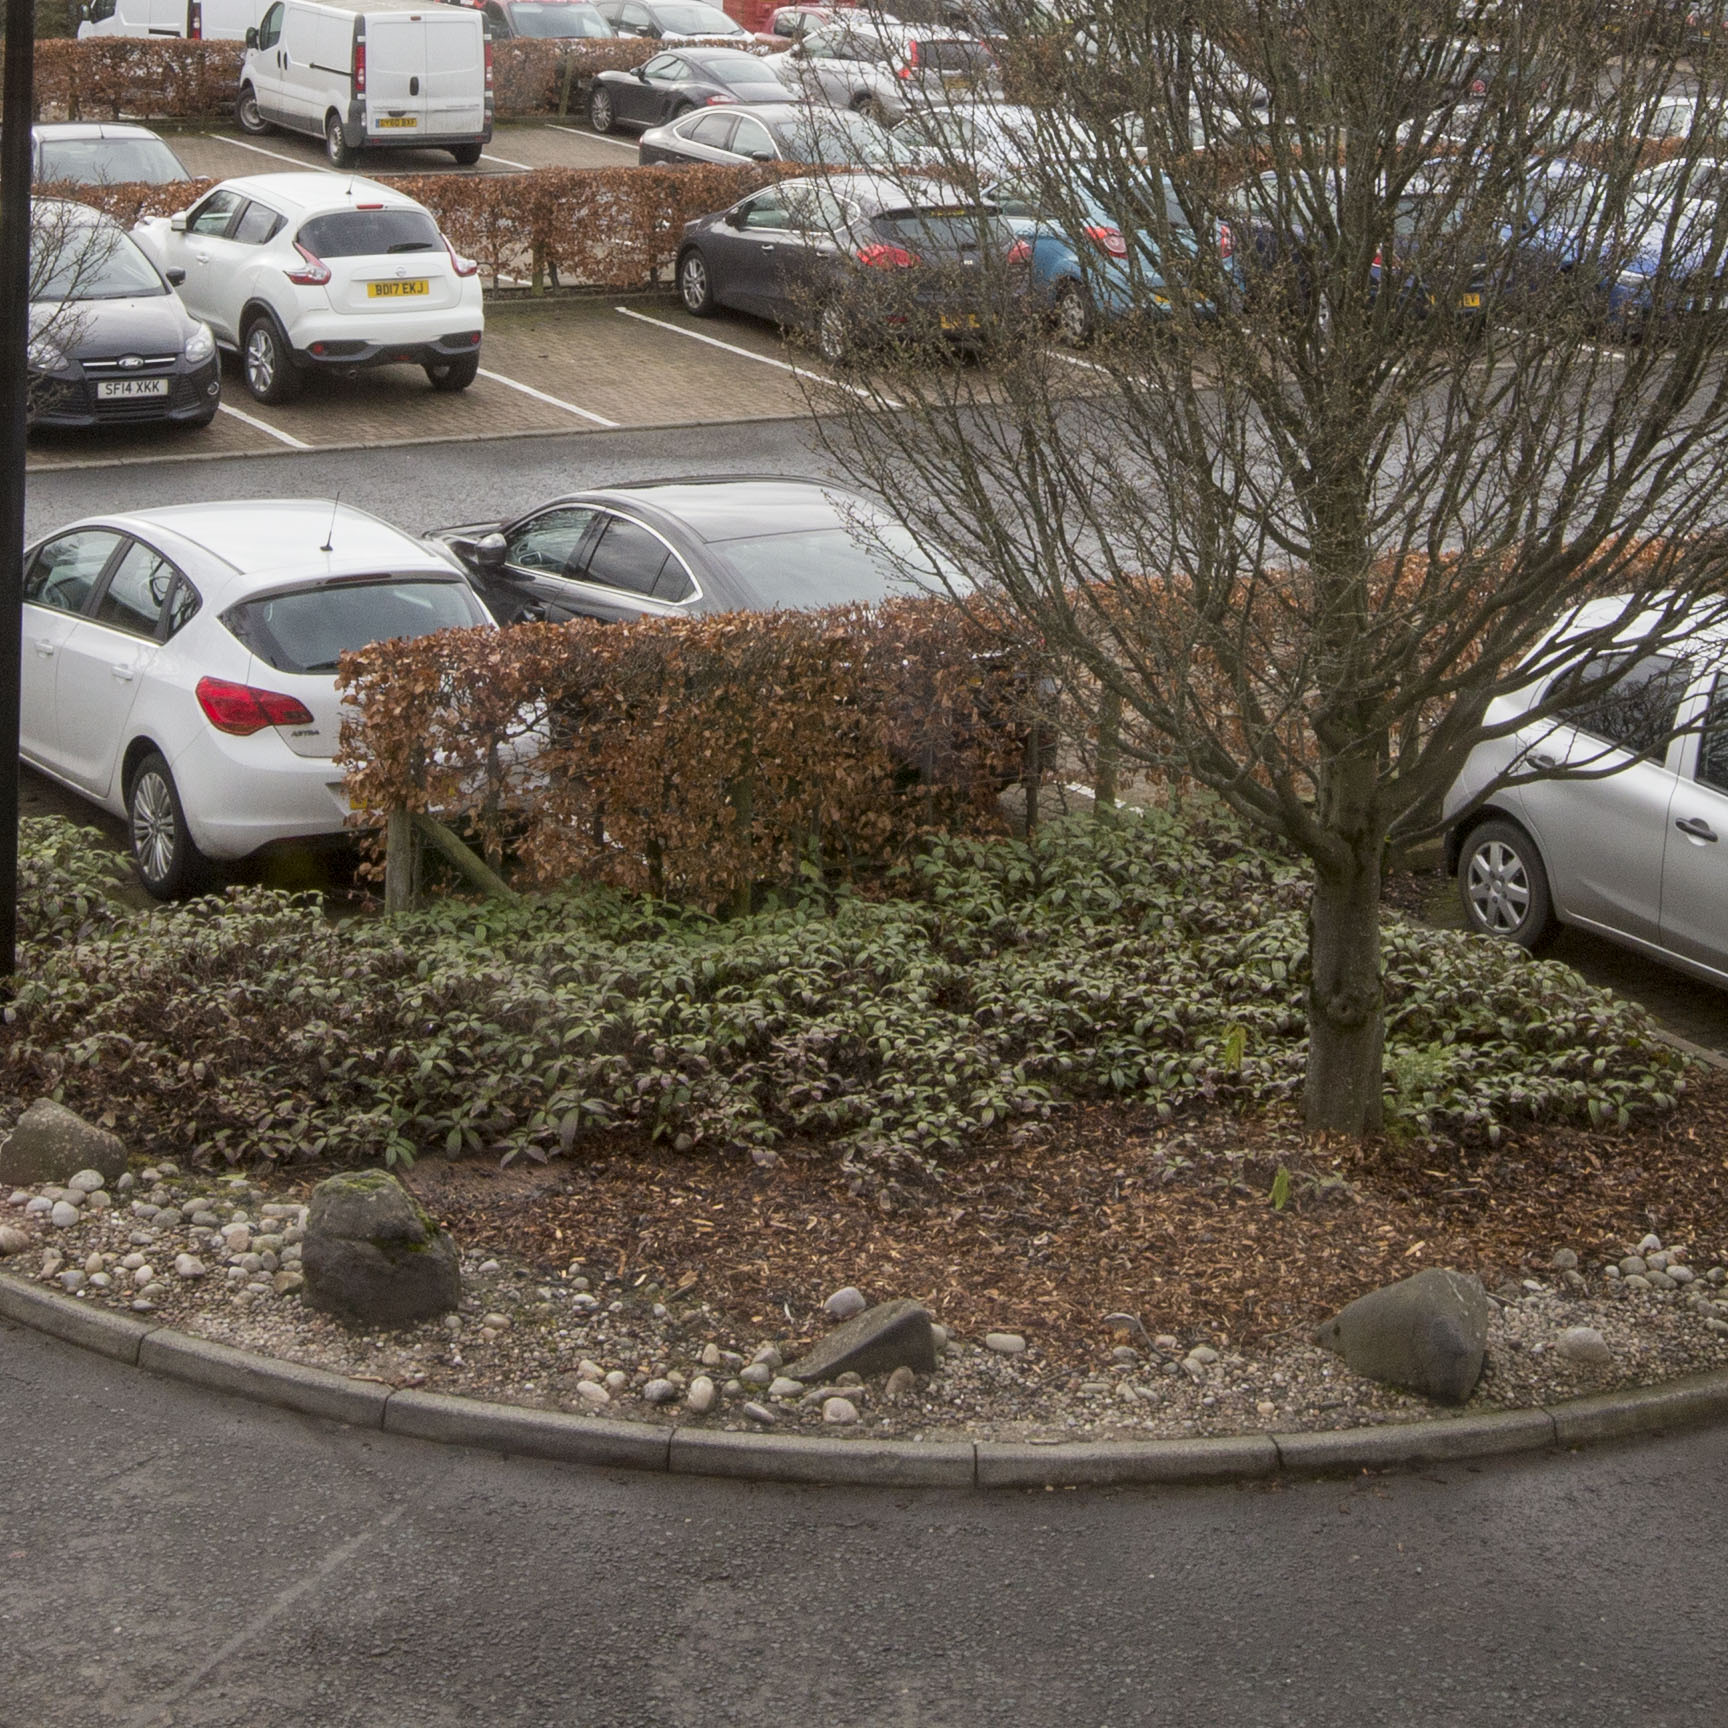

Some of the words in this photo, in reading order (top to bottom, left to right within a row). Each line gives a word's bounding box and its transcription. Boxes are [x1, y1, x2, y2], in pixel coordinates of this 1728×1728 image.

[375, 283, 400, 296] BD17
[402, 281, 424, 294] EKJ
[105, 382, 132, 395] SF14
[136, 380, 160, 393] XKK
